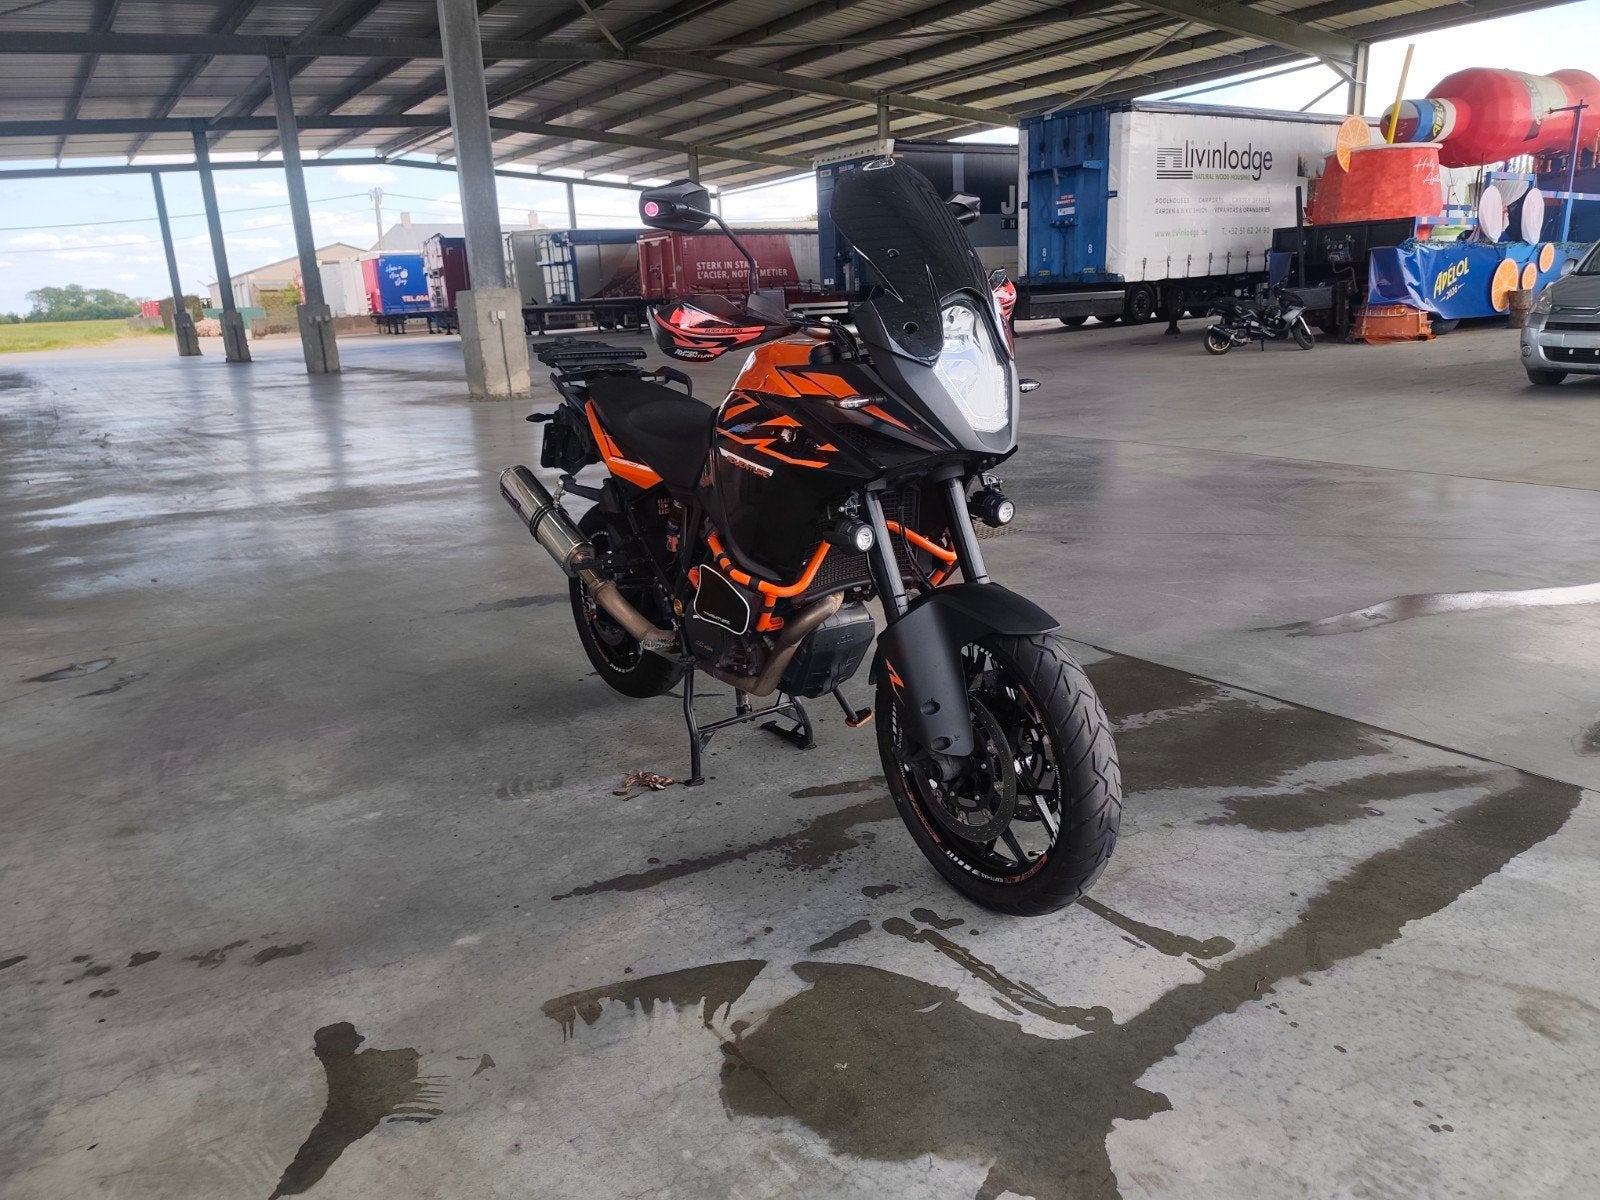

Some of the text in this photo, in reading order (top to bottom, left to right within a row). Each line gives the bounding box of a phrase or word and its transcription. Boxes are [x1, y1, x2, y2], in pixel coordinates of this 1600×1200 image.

[1185, 139, 1272, 181] livinlodge
[696, 260, 760, 271] STERK IN STAL
